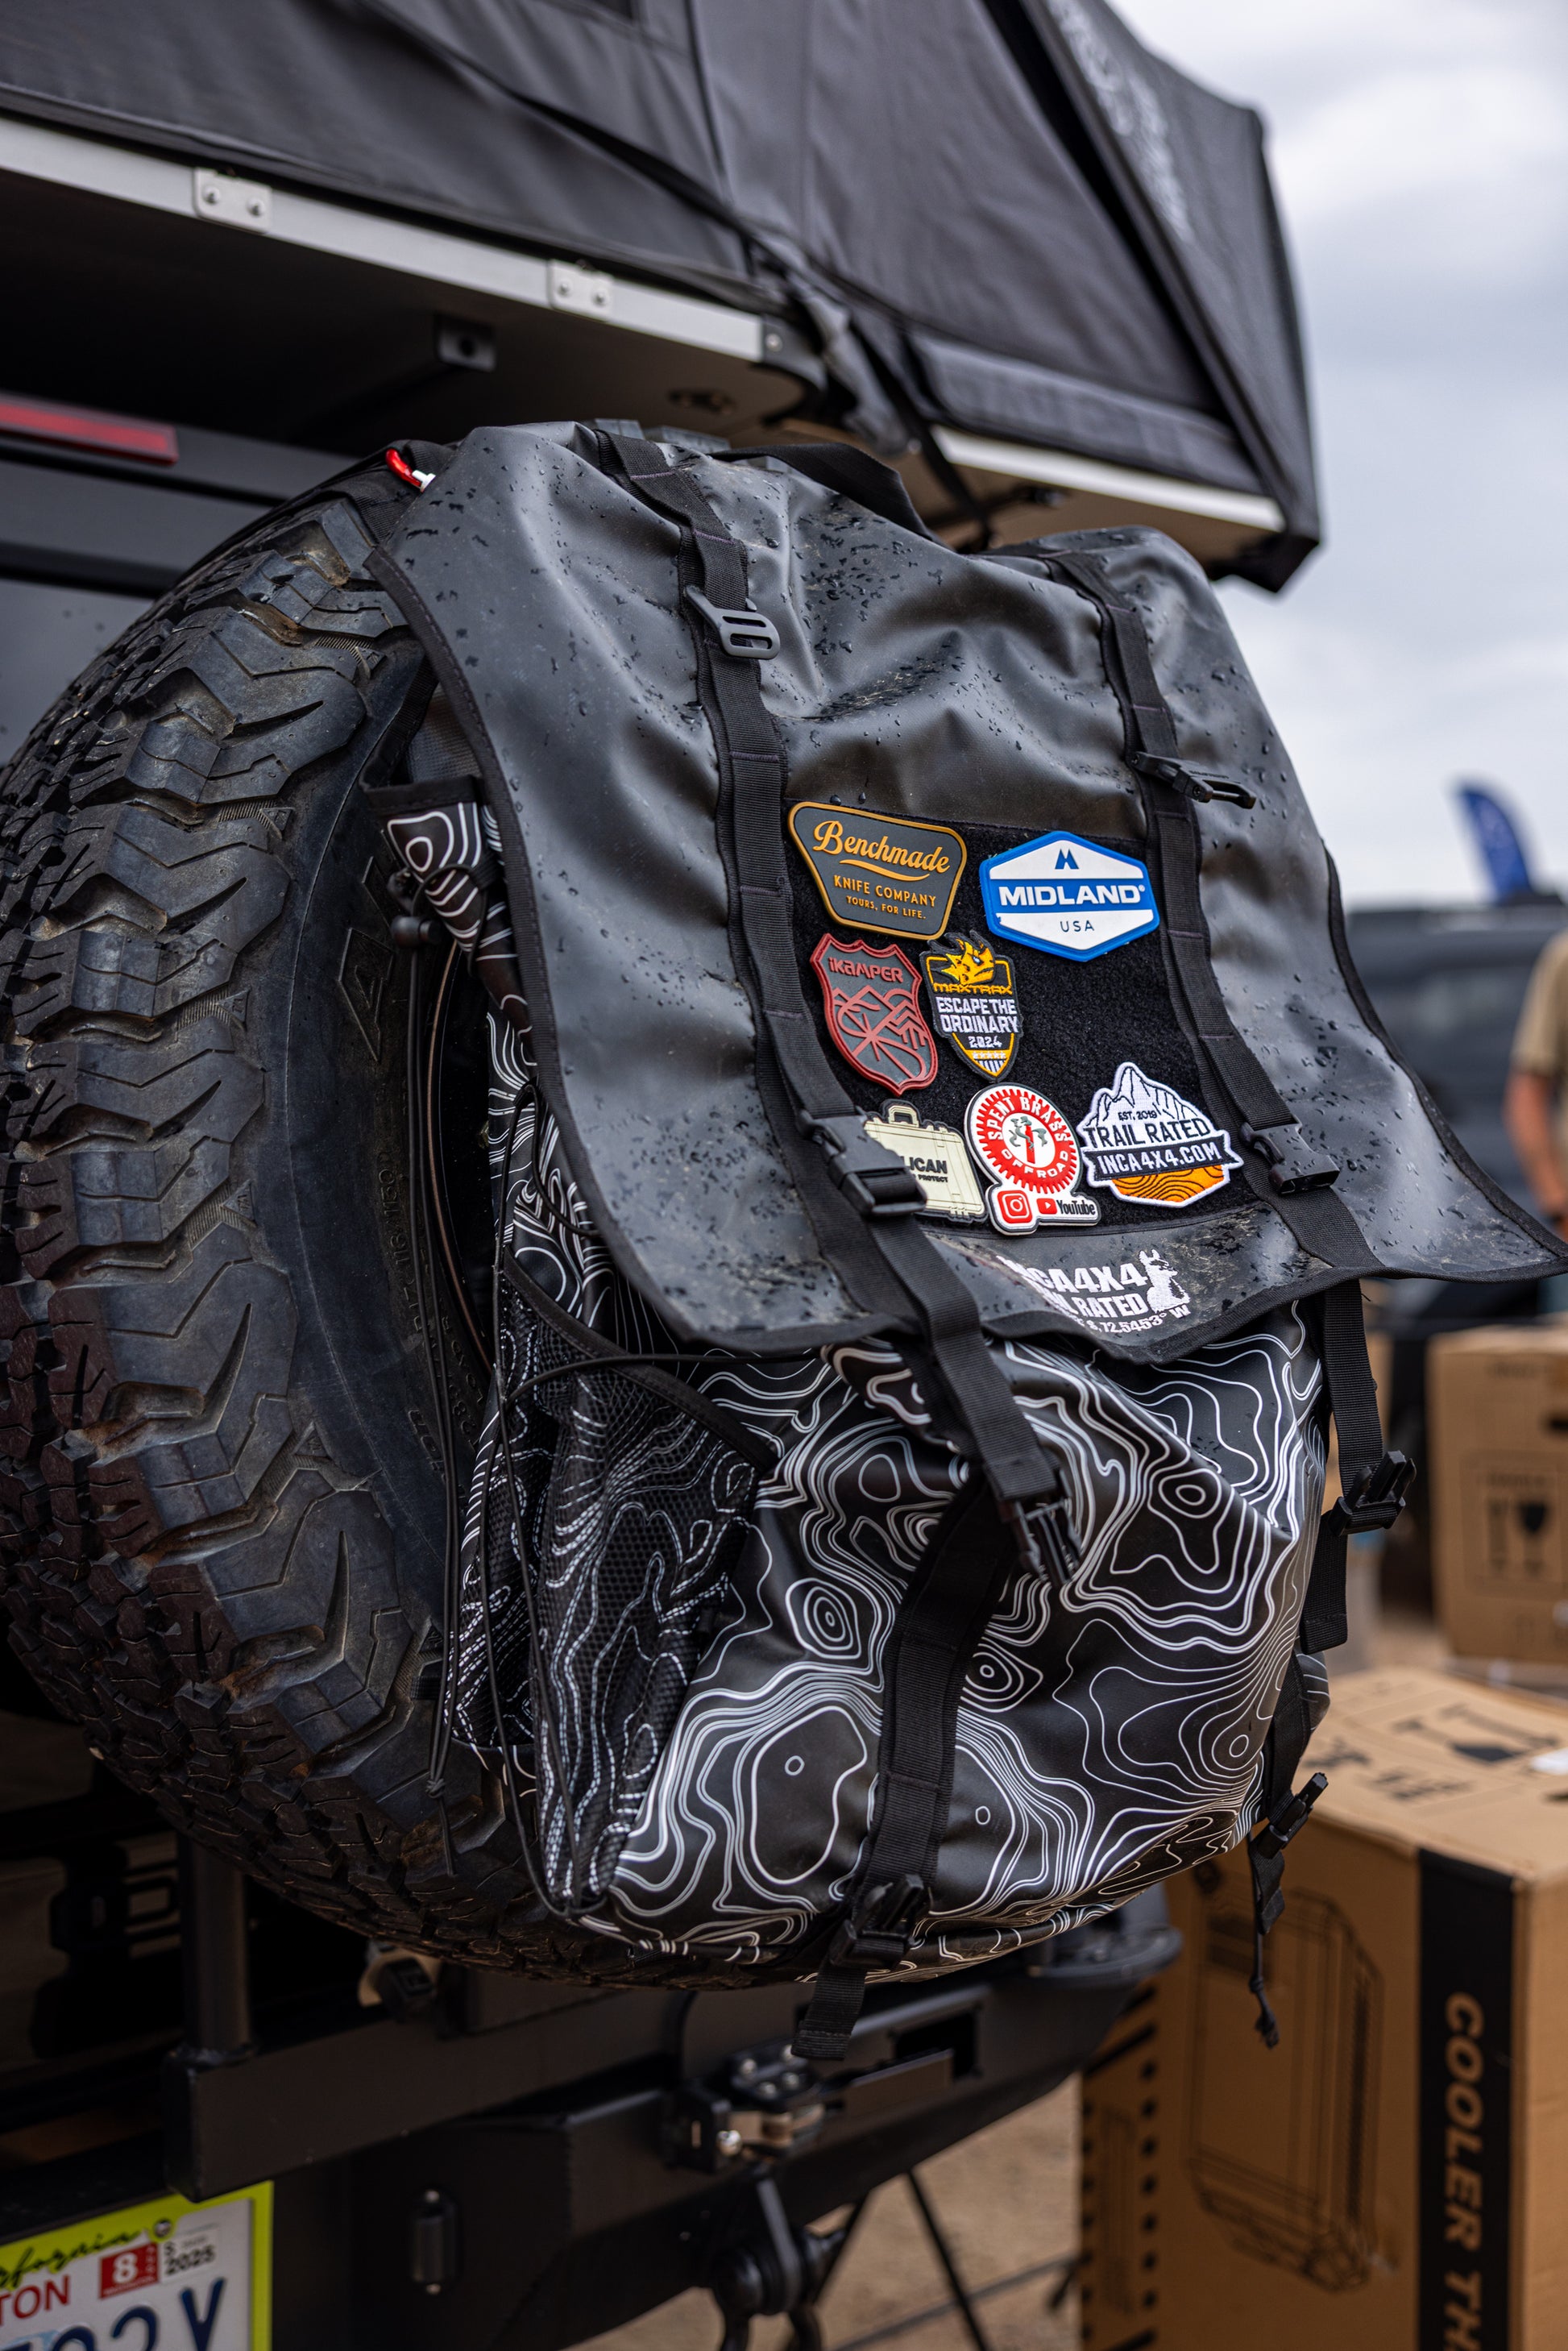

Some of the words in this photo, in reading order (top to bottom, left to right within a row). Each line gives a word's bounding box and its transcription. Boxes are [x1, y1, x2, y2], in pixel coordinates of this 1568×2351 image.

[812, 820, 951, 874] Benchmade
[833, 874, 870, 895] KNIFE
[875, 885, 936, 908] COMPANY
[846, 895, 878, 911] YOURS,
[881, 903, 898, 915] FOR
[902, 908, 927, 920] LIFE.
[1060, 920, 1094, 933] USA
[933, 982, 1013, 995] MAXTRAX
[935, 996, 990, 1014] ESCAPE
[988, 999, 1018, 1015] THE
[940, 1014, 1018, 1033] ORDINARY
[968, 1035, 1002, 1049] 2024
[986, 1096, 1015, 1140] SPENT
[1019, 1096, 1069, 1142] BRASS
[1136, 1110, 1158, 1120] 2019
[1083, 1122, 1146, 1149] TRAIL
[1144, 1118, 1210, 1147] RATED
[1001, 1148, 1069, 1178] OFFROAD
[1097, 1141, 1222, 1175] INCA4X4.COM
[917, 1173, 948, 1183] PROTECT
[1056, 1199, 1096, 1215] YouTube
[1071, 1293, 1149, 1319] RATED
[1168, 1304, 1191, 1319] W
[1445, 1992, 1485, 2253] COOLER
[112, 2252, 139, 2284] 8
